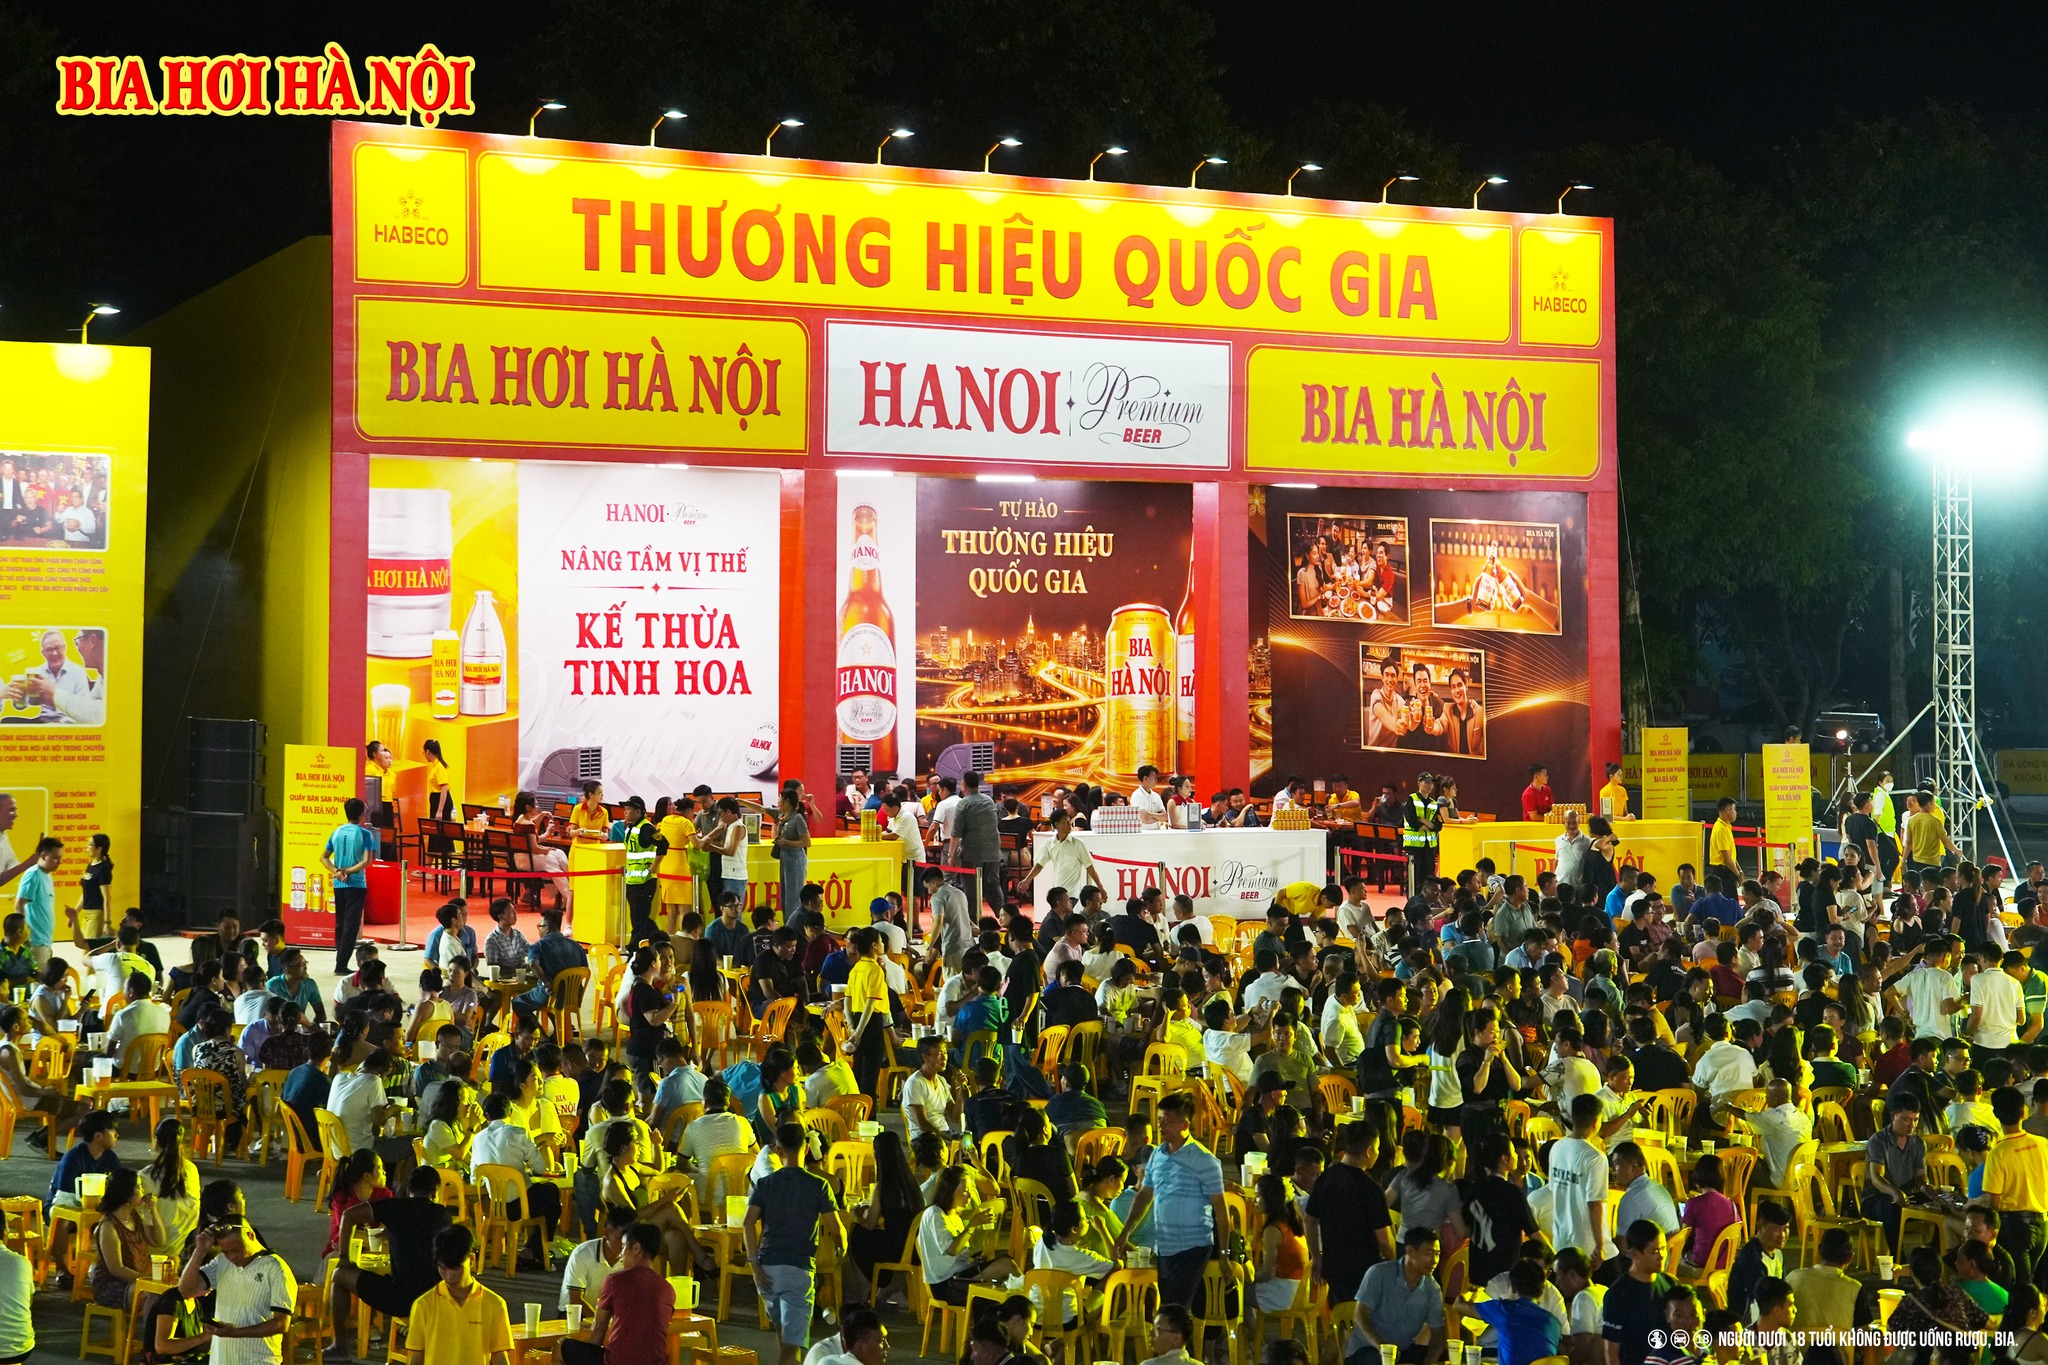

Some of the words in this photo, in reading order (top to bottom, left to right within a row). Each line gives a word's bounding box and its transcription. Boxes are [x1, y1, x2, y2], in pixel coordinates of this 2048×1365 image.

[374, 224, 449, 246] HABECO
[572, 197, 891, 288] THƯƠNG
[927, 212, 1082, 306] HIỆU
[1113, 221, 1302, 314] QUỐC
[1330, 251, 1438, 320] GIA
[1533, 296, 1588, 314] HABECO
[385, 340, 479, 405] BIA
[490, 344, 590, 409] HƠI
[603, 335, 678, 413] HÀ
[689, 342, 782, 432] NỘI
[858, 359, 1061, 436] HANOI
[1079, 362, 1204, 430] Premium
[1300, 382, 1381, 447] BIA
[1388, 372, 1457, 450] HÀ
[1461, 377, 1547, 467] NỘI
[1123, 428, 1162, 443] BEER
[606, 503, 665, 523] HANOI
[999, 500, 1020, 521] TỰ
[1025, 498, 1059, 519] HÀO
[942, 526, 1047, 556] THƯƠNG
[1054, 525, 1114, 562] HIỆU
[561, 545, 622, 571] NÂNG
[627, 544, 672, 572] TẦM
[679, 551, 701, 578] VỊ
[706, 546, 750, 573] THẾ
[374, 569, 402, 587] HƠI
[405, 567, 428, 589] HÀ
[430, 567, 449, 589] NỘI
[969, 560, 1038, 598] QUỐC
[1045, 569, 1088, 595] GIA
[576, 600, 628, 649] KẾ
[635, 604, 740, 649] THỪA
[1129, 638, 1153, 657] BIA
[564, 660, 659, 696] TINH
[674, 660, 751, 696] HOA
[840, 668, 893, 696] HANOI
[1111, 661, 1136, 696] HÀ
[1138, 662, 1171, 702] NỘI
[296, 772, 306, 780] BIA
[302, 805, 312, 813] BIA
[314, 805, 324, 814] HÀ
[325, 806, 338, 816] NỘI
[1219, 860, 1279, 895] Premium
[1240, 891, 1260, 900] BEER
